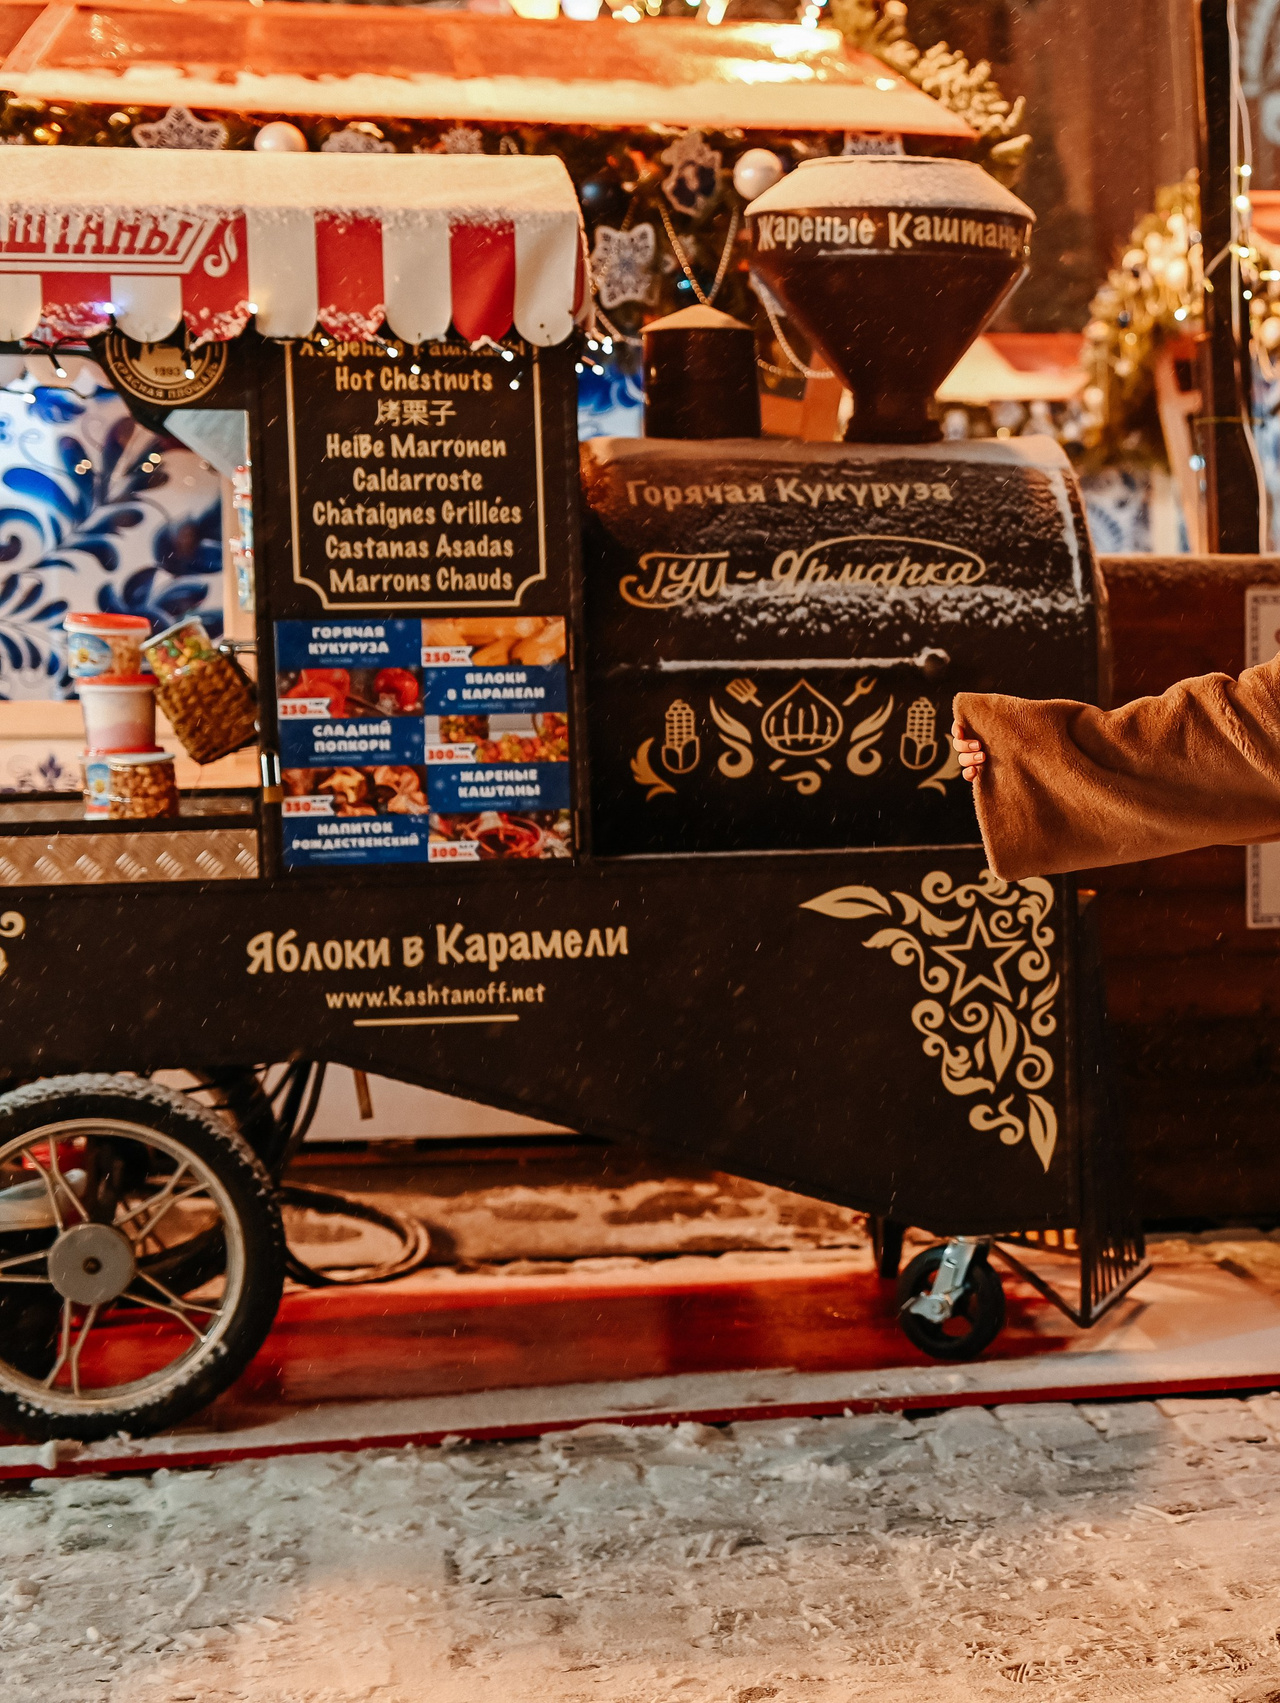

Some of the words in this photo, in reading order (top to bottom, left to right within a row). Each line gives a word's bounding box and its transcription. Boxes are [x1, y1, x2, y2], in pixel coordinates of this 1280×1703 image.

[0, 211, 193, 255] ШТАНЫ
[757, 214, 876, 251] Жареные
[888, 211, 1025, 258] Каштаны
[335, 366, 374, 391] Hot
[379, 366, 494, 391] Chestnuts
[375, 399, 456, 426] 烤栗子
[390, 433, 507, 458] Marronen
[352, 466, 484, 491] Caldarroste
[626, 480, 766, 511] Горячая
[774, 478, 953, 507] Кукуруза
[441, 496, 522, 524] Grillées
[325, 534, 430, 559] Castanas
[435, 533, 514, 557] Asadas
[329, 568, 431, 593] Marrons
[436, 566, 514, 591] Chauds
[311, 625, 386, 639] ГОРЯЧАЯ
[308, 641, 390, 655] КУКУРУЗА
[465, 671, 527, 685] ЯБЛОКИ
[446, 688, 458, 701] В
[461, 687, 545, 700] КАРАМЕЛИ
[312, 720, 392, 738] СЛАДКИЙ
[314, 739, 391, 753] ПОПКОРН
[460, 769, 538, 783] ЖАРЕНЫЕ
[458, 784, 541, 798] КАШТАНЫ
[317, 822, 393, 836] НАПИТОК
[292, 833, 419, 851] РОЖДЕСТВЕНСКИЙ
[246, 929, 391, 975] Яблоки
[402, 935, 424, 968] в
[435, 922, 629, 972] Карамели
[325, 981, 547, 1009] www.Kashtanoff.net
